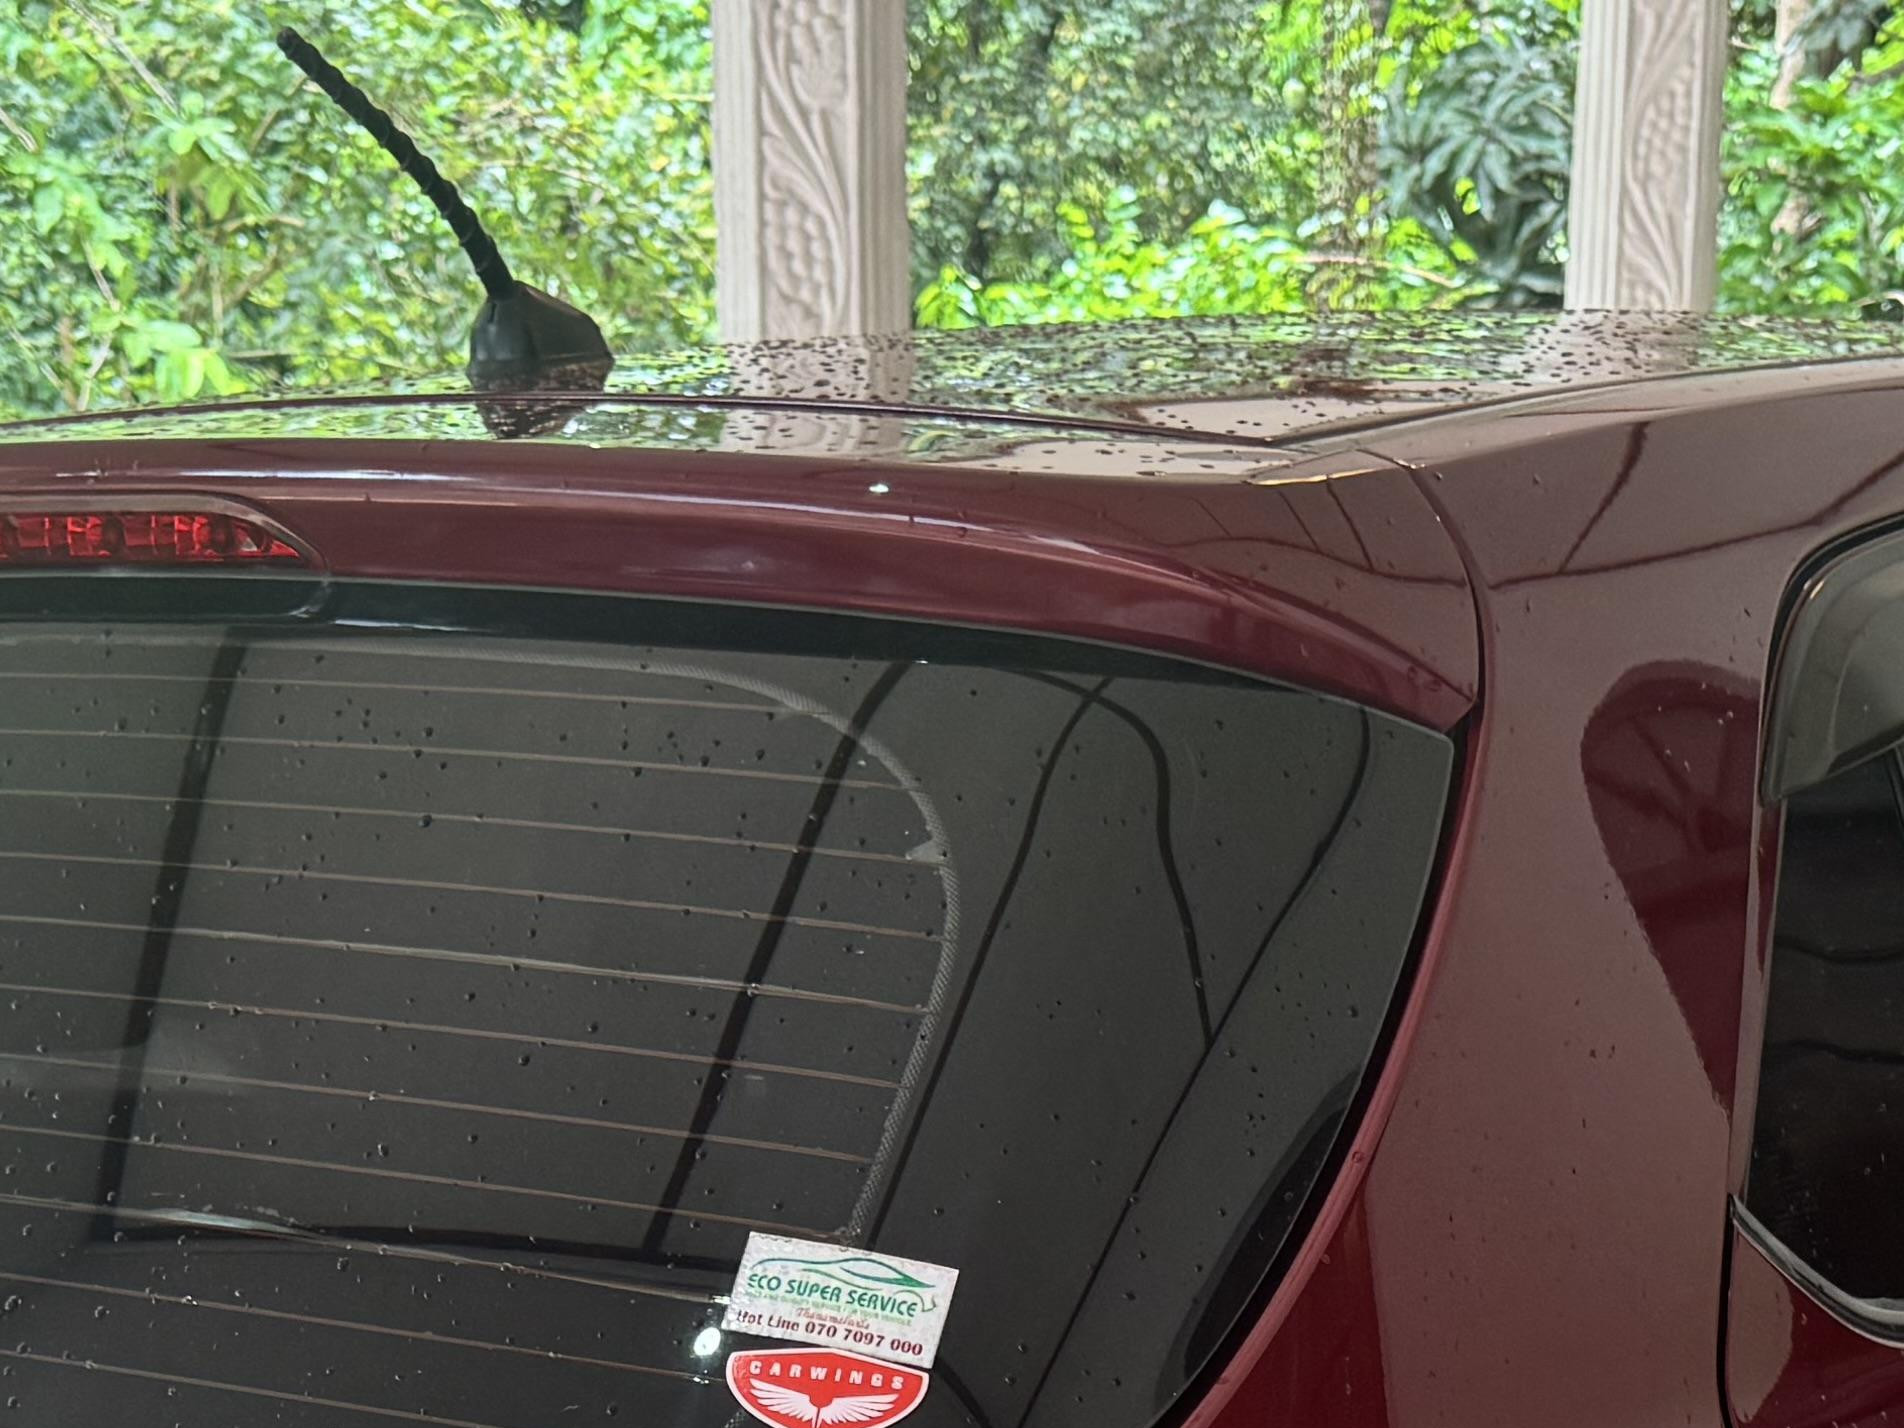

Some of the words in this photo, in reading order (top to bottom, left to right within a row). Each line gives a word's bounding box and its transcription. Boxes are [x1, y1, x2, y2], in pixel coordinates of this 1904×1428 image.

[747, 1273, 781, 1291] ECO
[785, 1279, 842, 1301] SUPER
[845, 1290, 918, 1318] SERVICE
[737, 1309, 762, 1325] Hot
[767, 1313, 799, 1332] Line
[805, 1321, 838, 1338] 070
[843, 1328, 885, 1348] 7097
[890, 1338, 923, 1356] 000
[749, 1360, 904, 1390] CARWINGS
